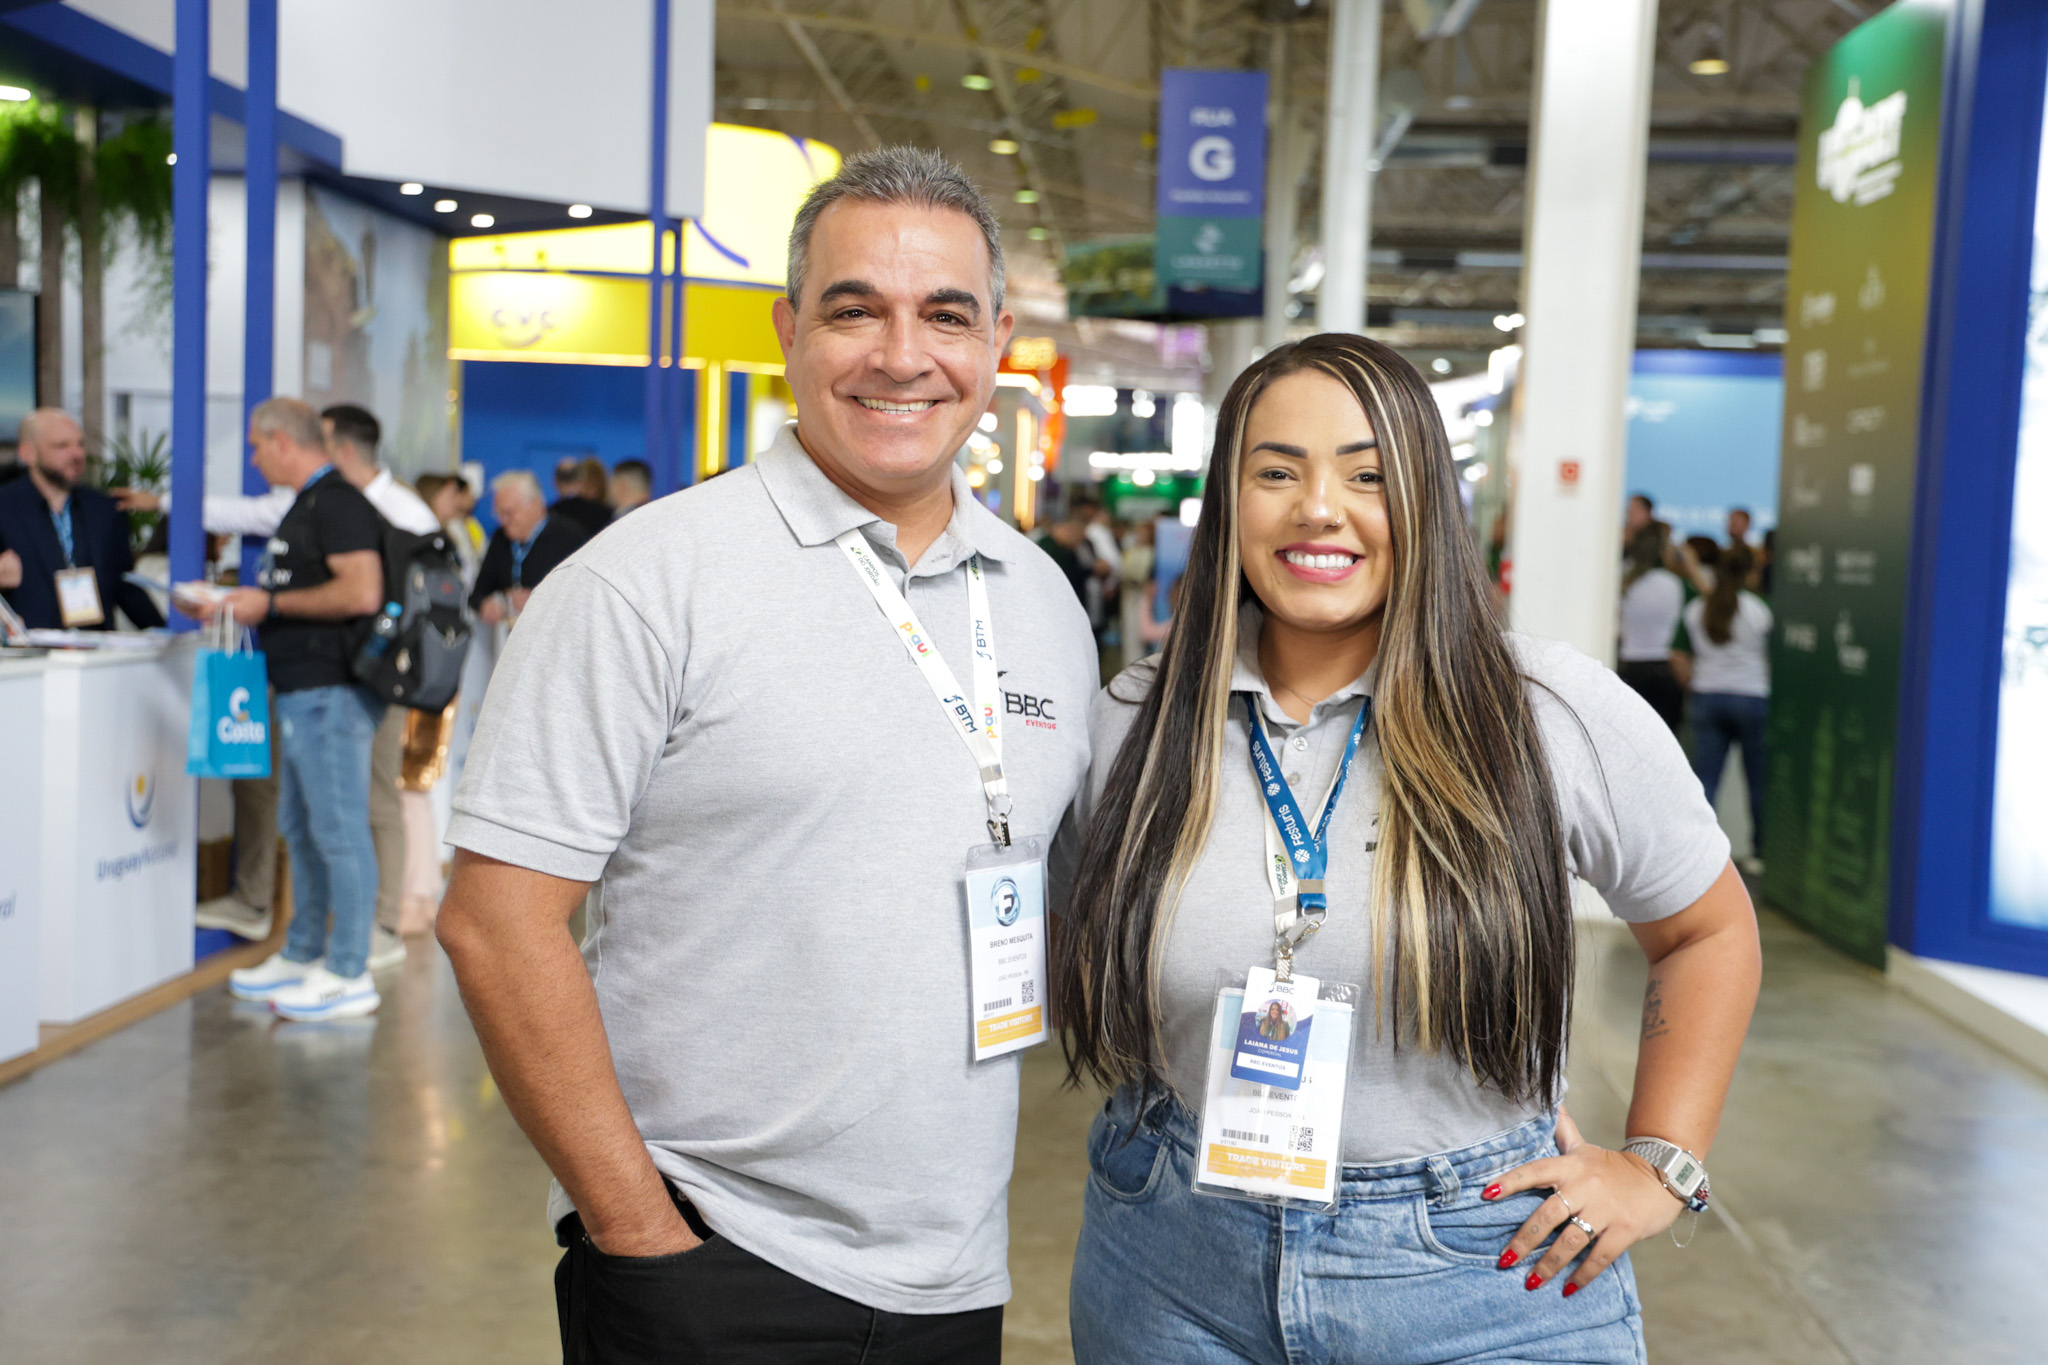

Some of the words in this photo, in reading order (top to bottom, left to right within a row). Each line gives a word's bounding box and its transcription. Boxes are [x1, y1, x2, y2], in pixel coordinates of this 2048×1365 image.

[1188, 134, 1236, 182] G
[863, 554, 880, 577] CAMPOS
[975, 620, 987, 648] BTM
[1004, 692, 1056, 720] BBC
[955, 704, 978, 733] BTM
[1025, 719, 1057, 730] EVENTOS
[217, 716, 266, 745] Costa
[1252, 740, 1275, 783] Festuris
[1278, 804, 1305, 847] Festuris
[990, 938, 1008, 949] BRENO
[1009, 933, 1033, 945] MESQUITA
[1276, 985, 1295, 995] BBC
[1244, 1039, 1268, 1050] LAIANA
[1278, 1046, 1299, 1055] JESUS
[1261, 1061, 1286, 1071] EVENTOS
[1269, 1092, 1298, 1102] EVENTO
[1267, 1109, 1292, 1118] PESSOA
[1226, 1152, 1260, 1165] TRADE
[1261, 1157, 1307, 1173] VISITORS
